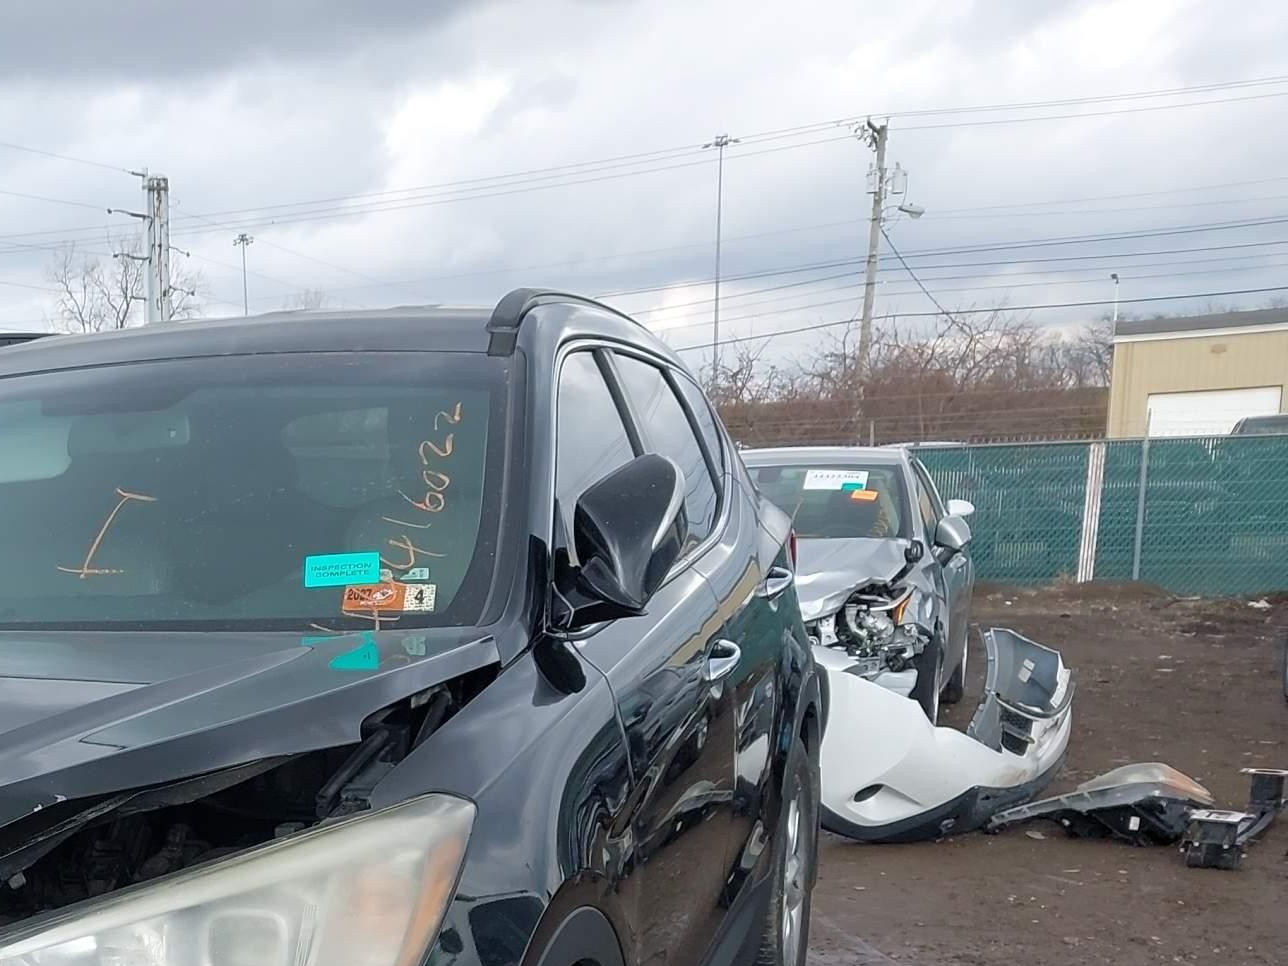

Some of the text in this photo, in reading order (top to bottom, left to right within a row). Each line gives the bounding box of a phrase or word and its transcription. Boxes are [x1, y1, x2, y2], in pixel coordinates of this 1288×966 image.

[310, 562, 372, 572] INSPECTION
[315, 569, 370, 578] COMPLETE
[414, 589, 425, 605] 4
